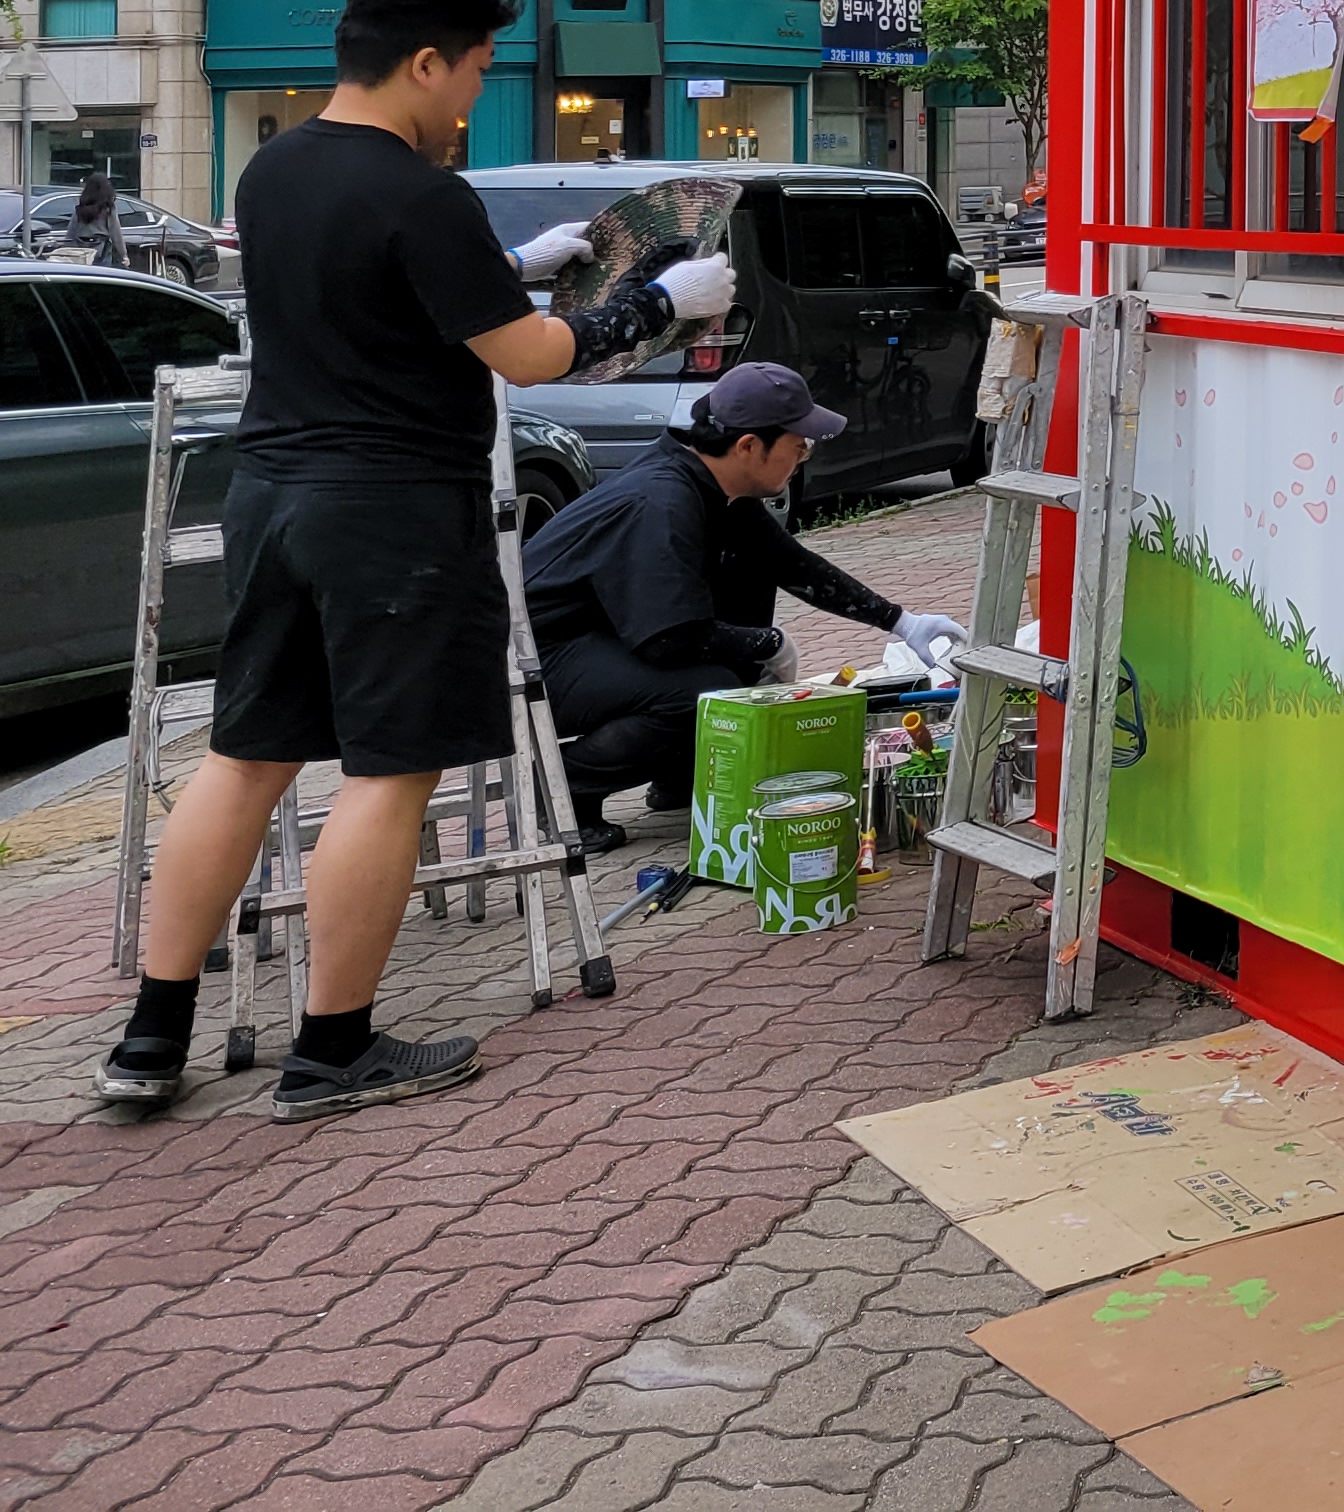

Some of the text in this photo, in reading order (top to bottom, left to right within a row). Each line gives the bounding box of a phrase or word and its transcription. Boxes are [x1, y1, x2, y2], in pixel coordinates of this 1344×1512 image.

[842, 0, 874, 23] 법무사
[830, 49, 914, 65] 326-1188 326-3030
[711, 718, 738, 731] NOROO
[796, 715, 838, 731] NOROO
[787, 816, 842, 836] NOROO
